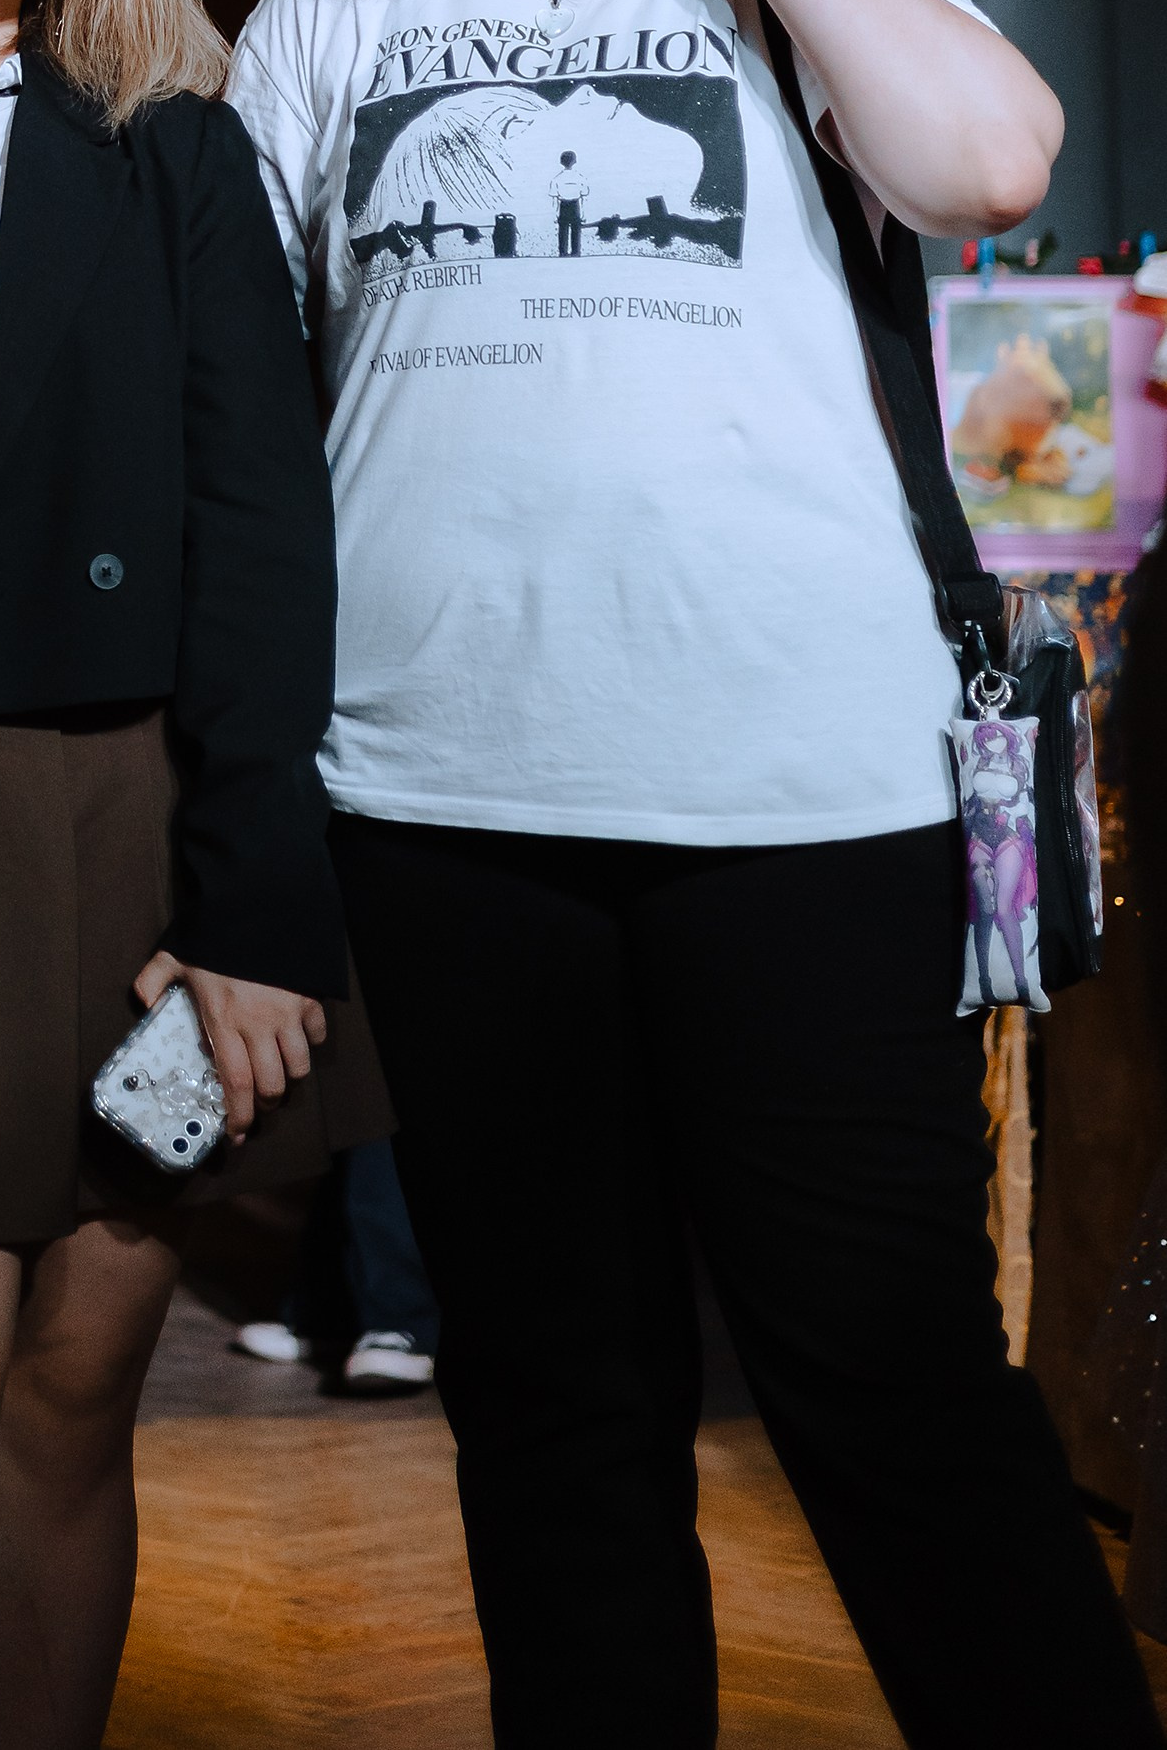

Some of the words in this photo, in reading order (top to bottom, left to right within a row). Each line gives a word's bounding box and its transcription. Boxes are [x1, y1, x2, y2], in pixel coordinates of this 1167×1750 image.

[374, 26, 439, 65] NEON
[441, 18, 552, 47] GENESIS
[359, 23, 738, 103] EVANGELION
[412, 264, 483, 291] REBIRTH
[520, 298, 556, 320] THE
[558, 297, 596, 319] END
[598, 296, 624, 318] OF
[627, 296, 743, 329] EVANGELION
[412, 348, 433, 369] OF
[435, 342, 544, 368] EVANGELION
